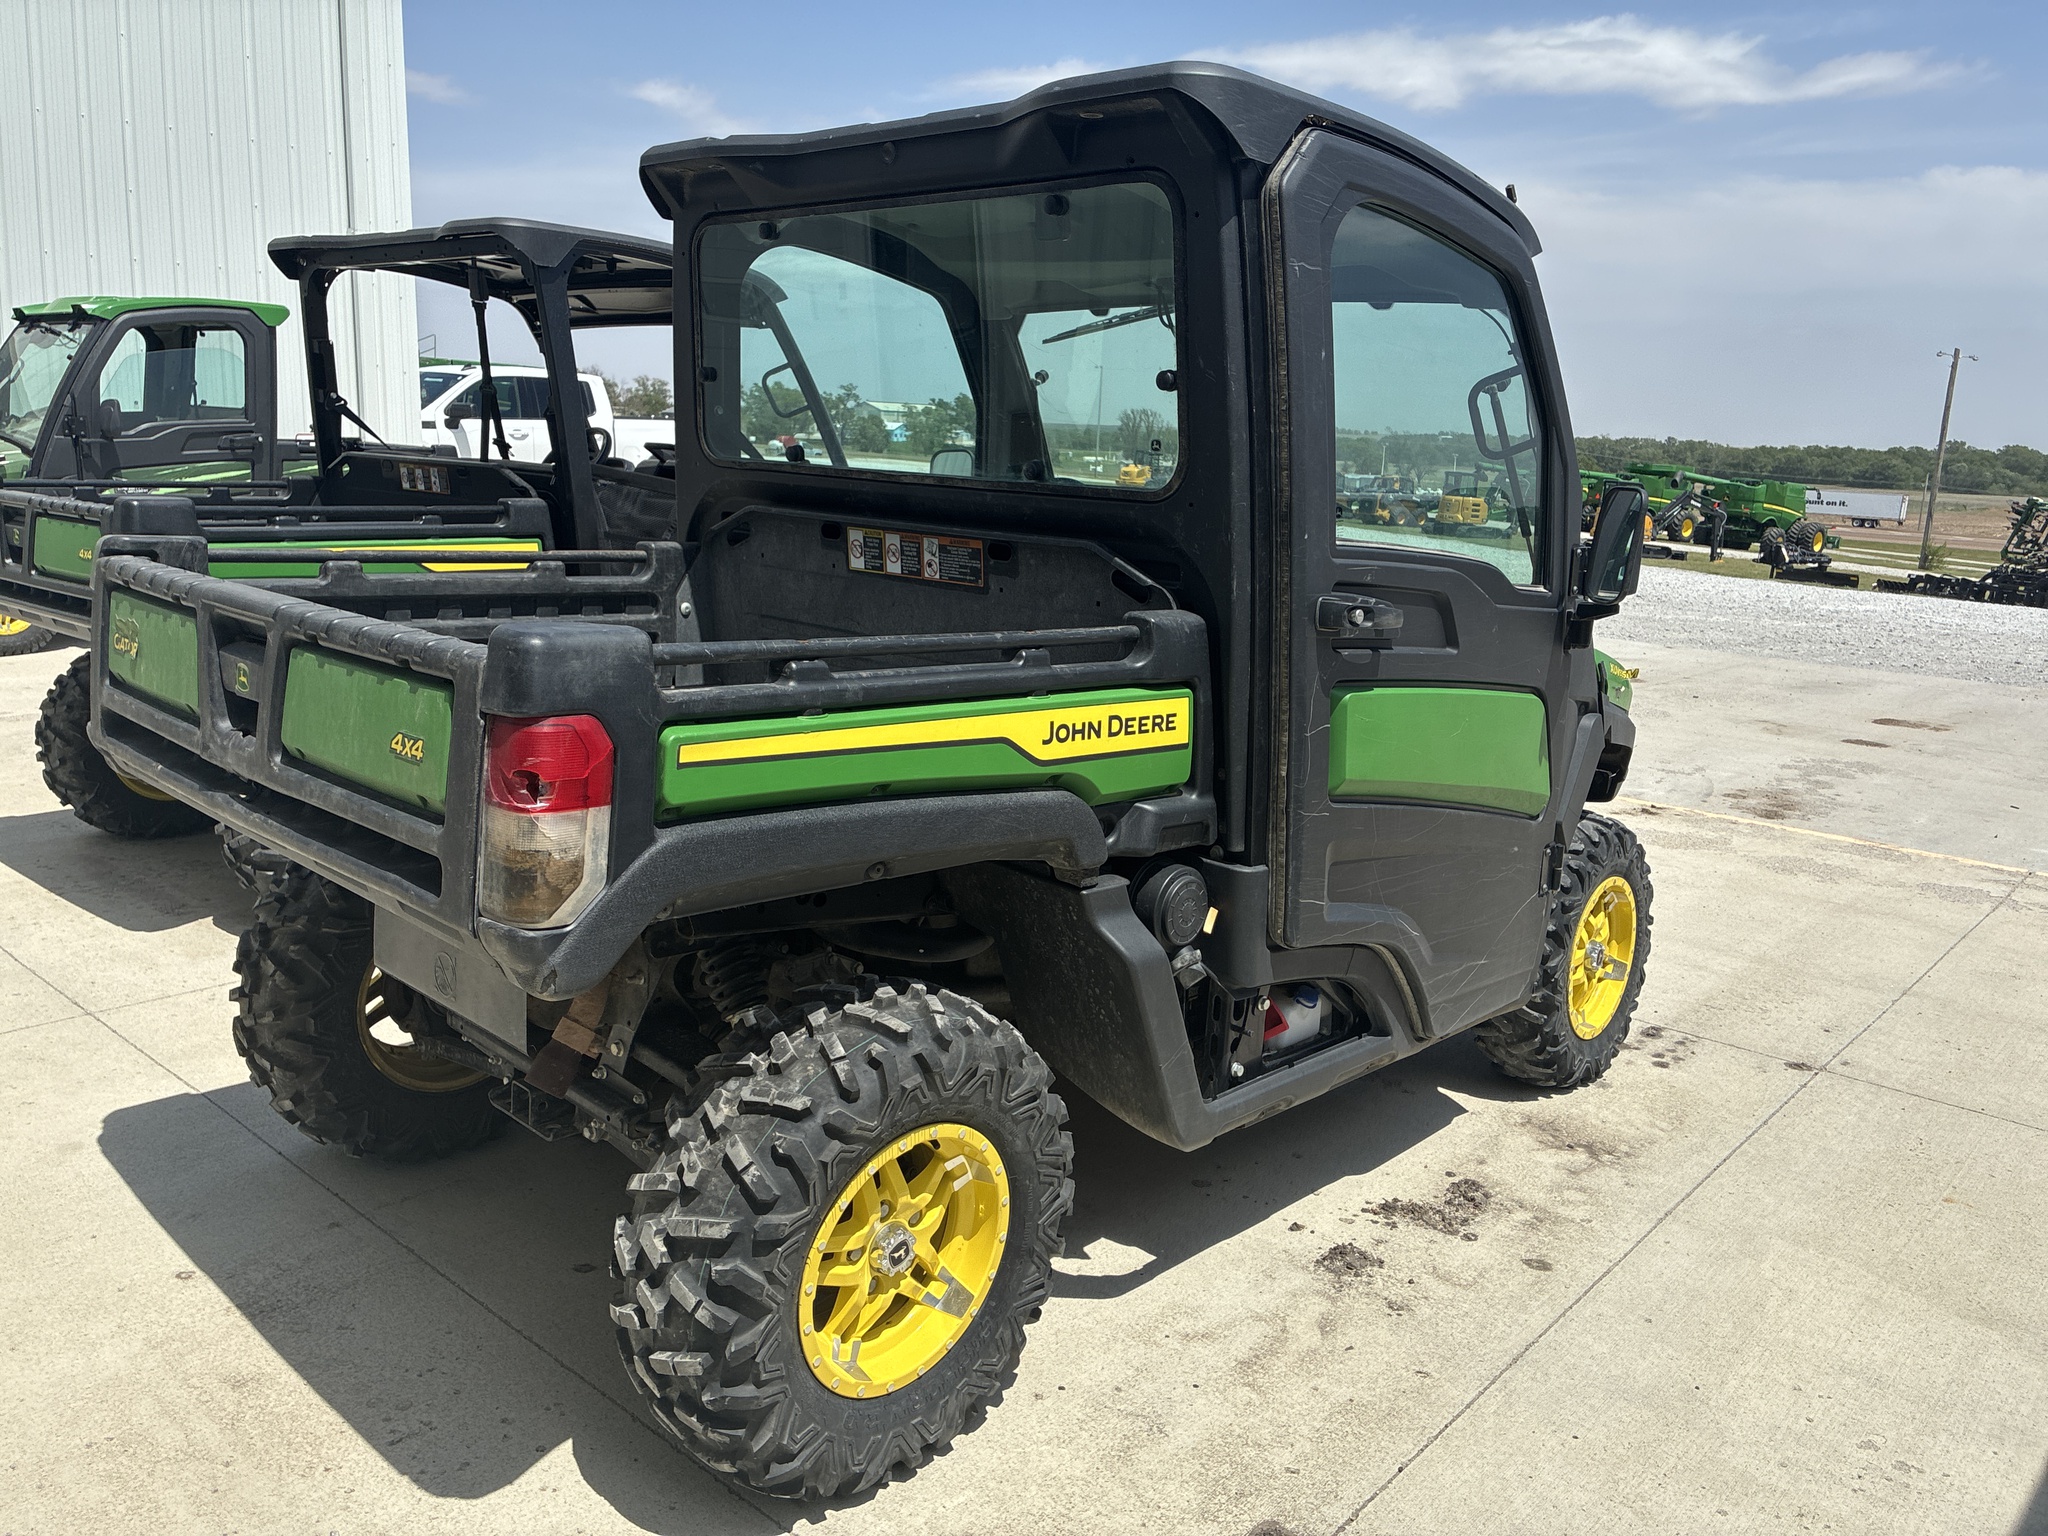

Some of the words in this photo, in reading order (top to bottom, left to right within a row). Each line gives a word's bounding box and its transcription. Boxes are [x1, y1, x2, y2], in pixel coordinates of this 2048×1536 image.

[1838, 500, 1848, 508] it.
[1041, 720, 1102, 746] JOHN
[1107, 712, 1178, 738] DEERE
